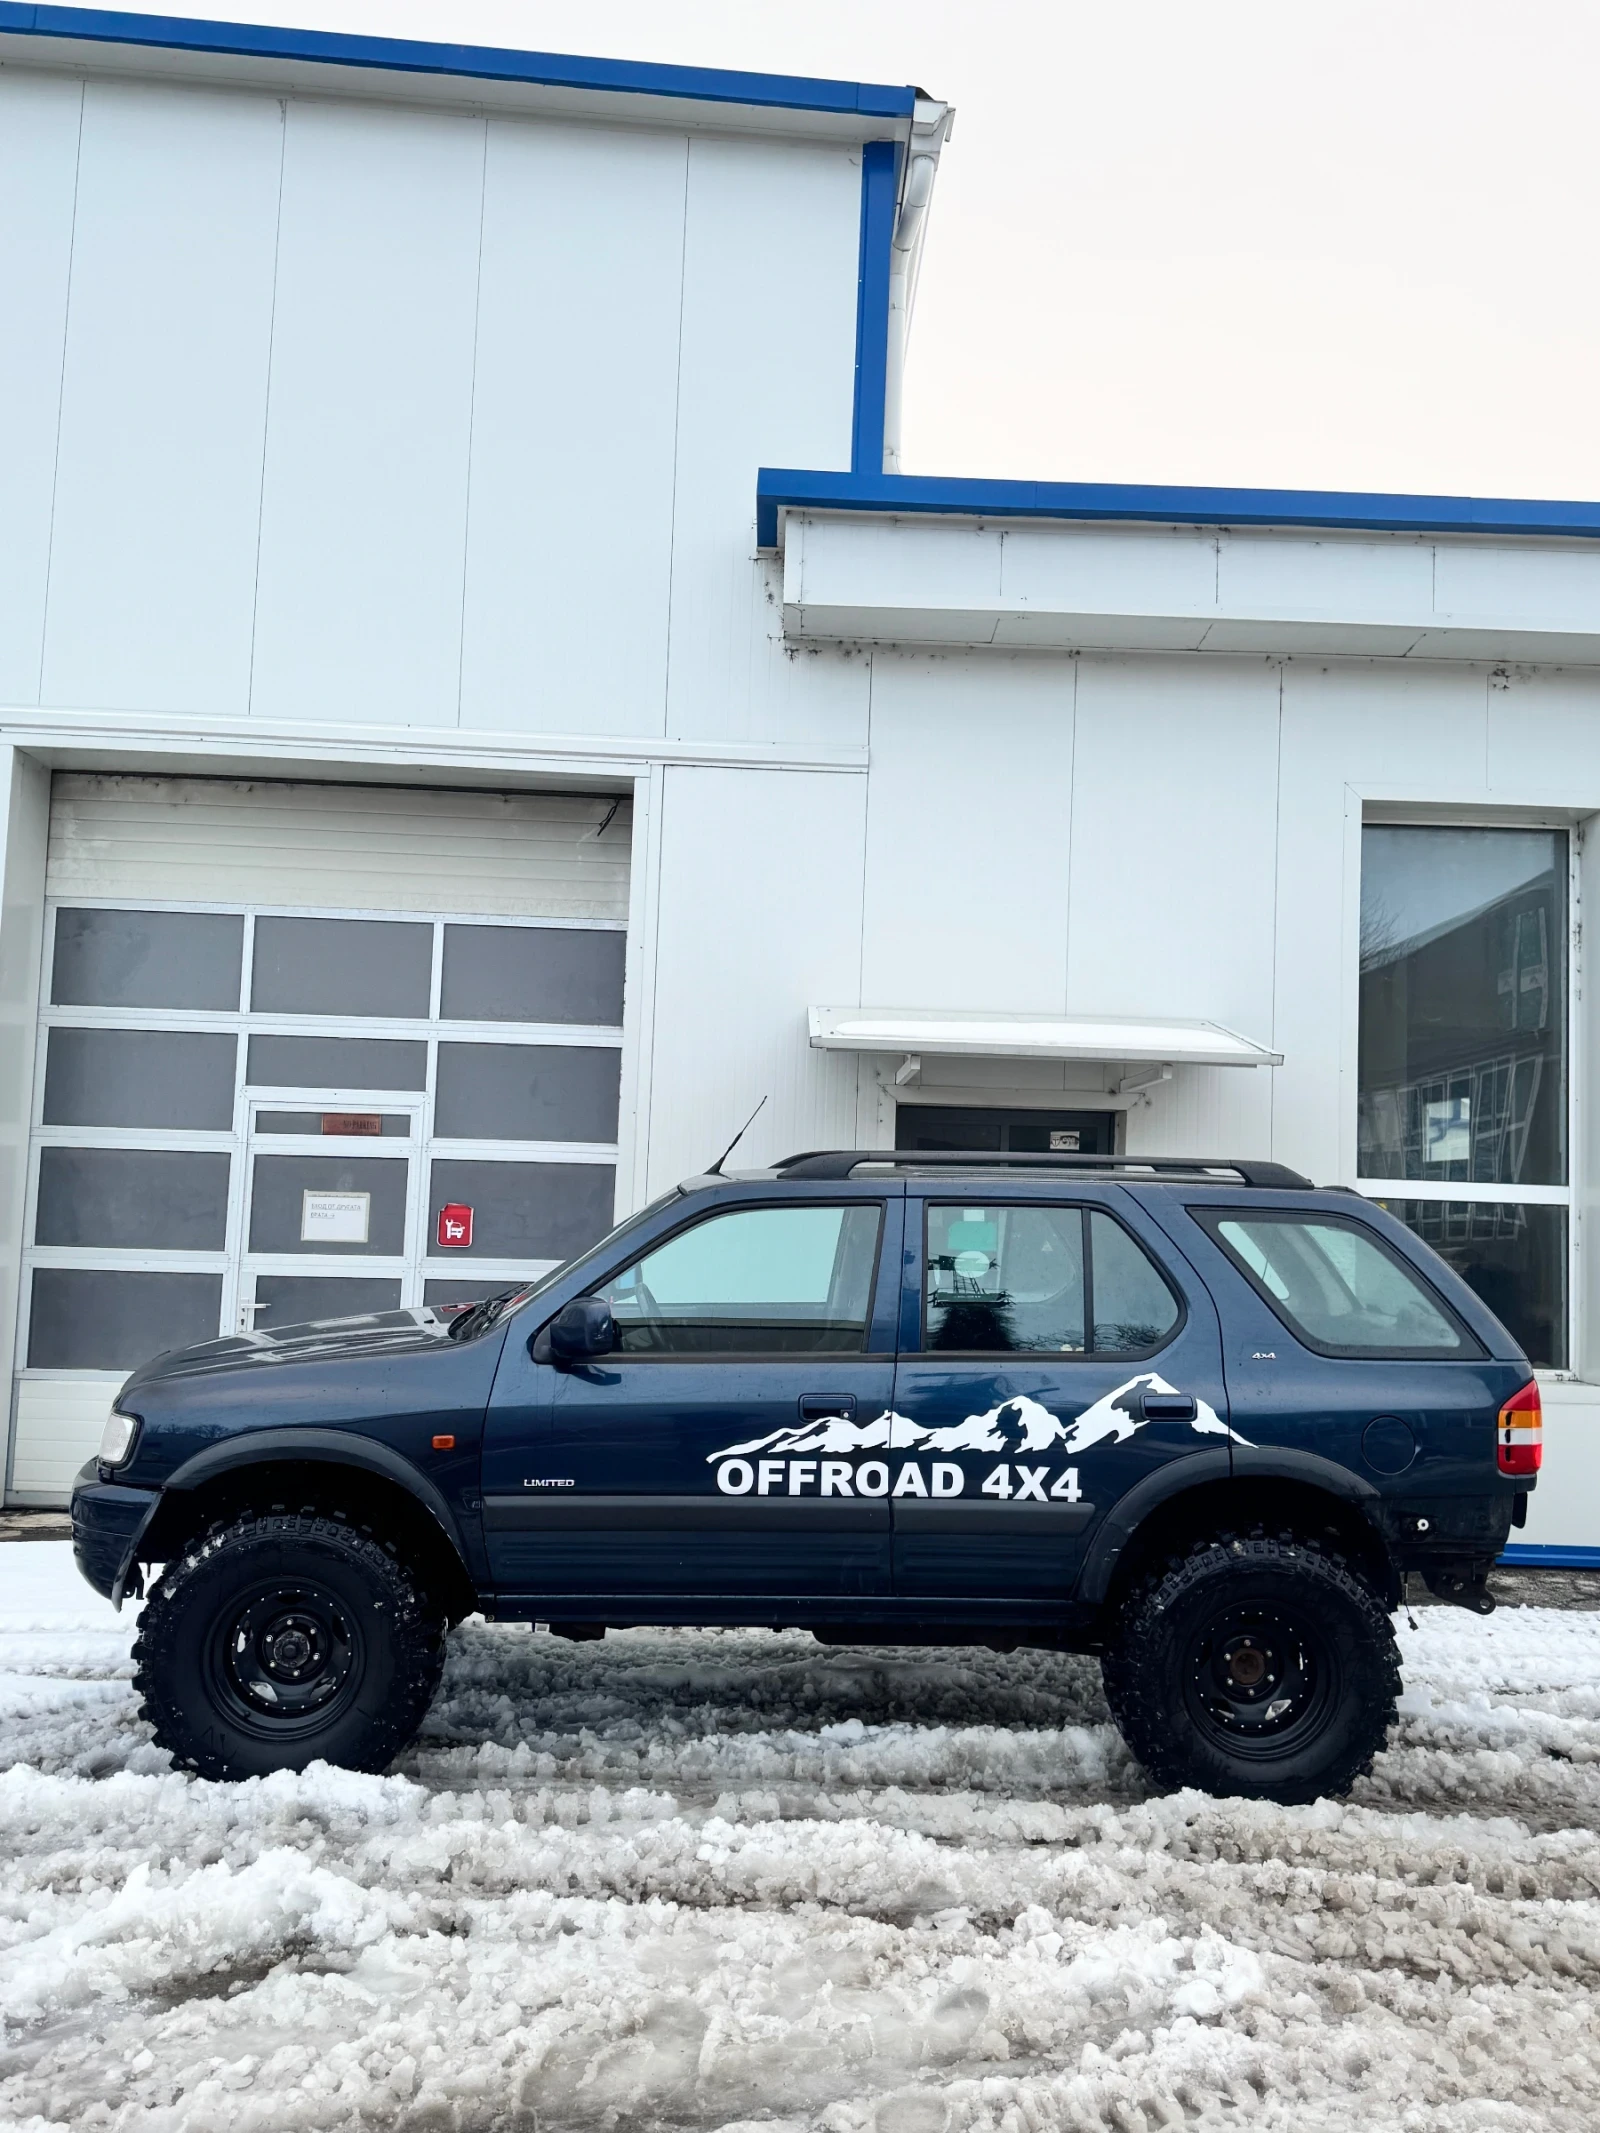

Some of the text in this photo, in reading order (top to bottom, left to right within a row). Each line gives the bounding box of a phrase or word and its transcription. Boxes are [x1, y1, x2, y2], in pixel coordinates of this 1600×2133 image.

[523, 1479, 575, 1487] LIMITED
[716, 1458, 1083, 1503] OFFROAD 4X4
